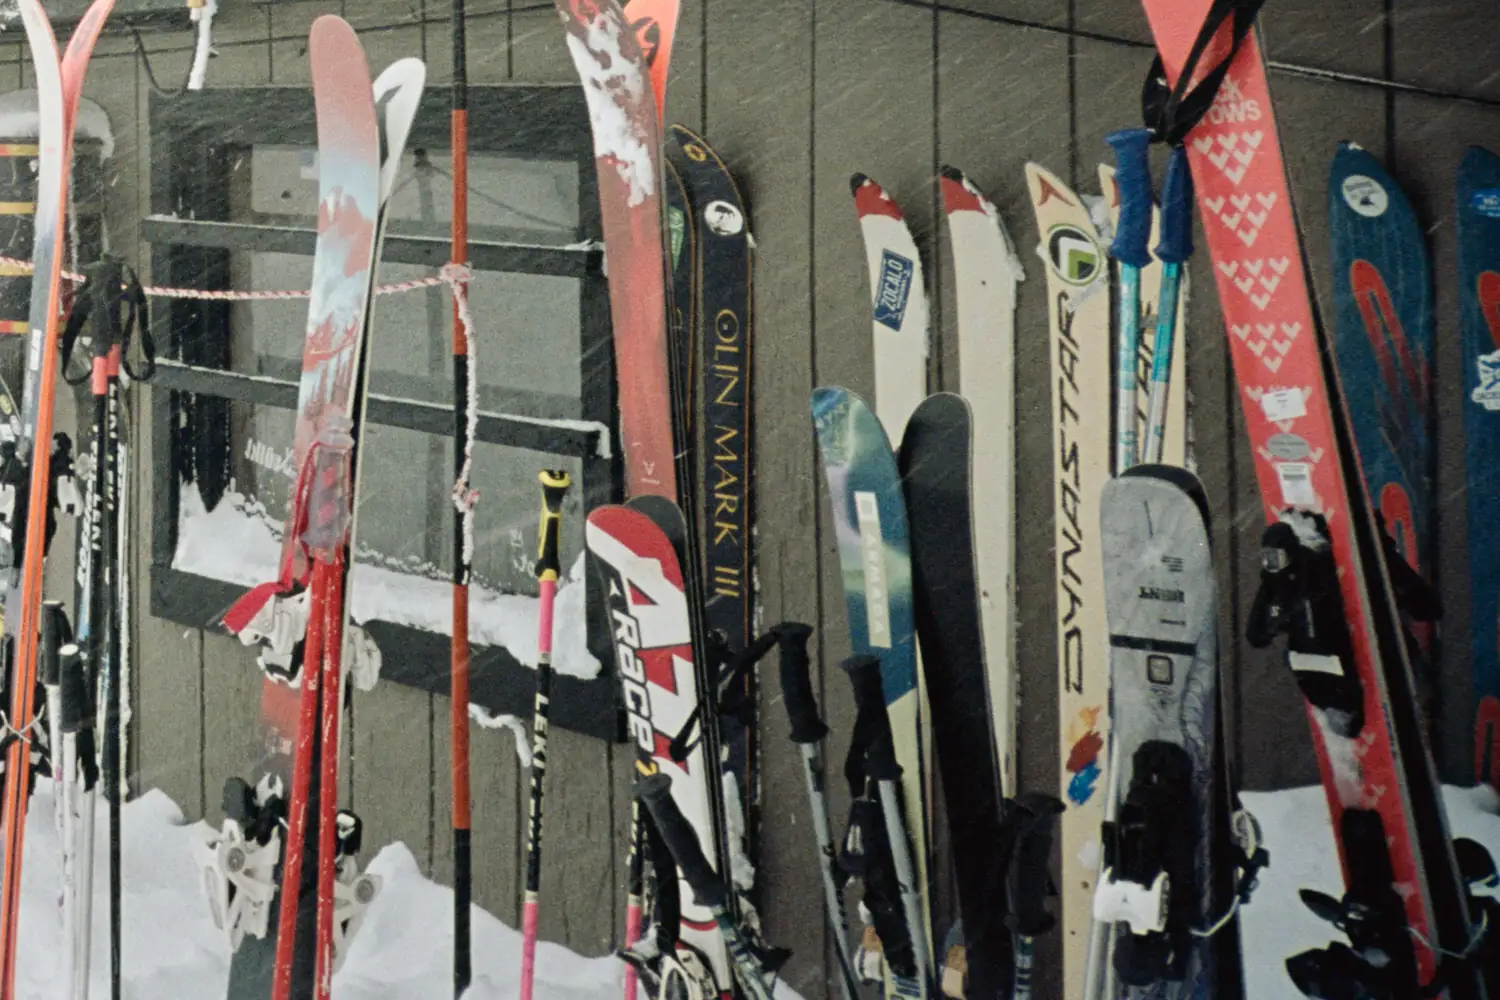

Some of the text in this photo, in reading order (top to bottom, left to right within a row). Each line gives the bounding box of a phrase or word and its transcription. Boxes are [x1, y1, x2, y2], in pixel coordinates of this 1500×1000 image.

[880, 259, 904, 312] ZOCALO
[713, 308, 740, 598] OLIN MARK III
[1056, 290, 1084, 695] DYNASTAR
[862, 531, 887, 635] ARMADA
[533, 692, 550, 770] LEKI
